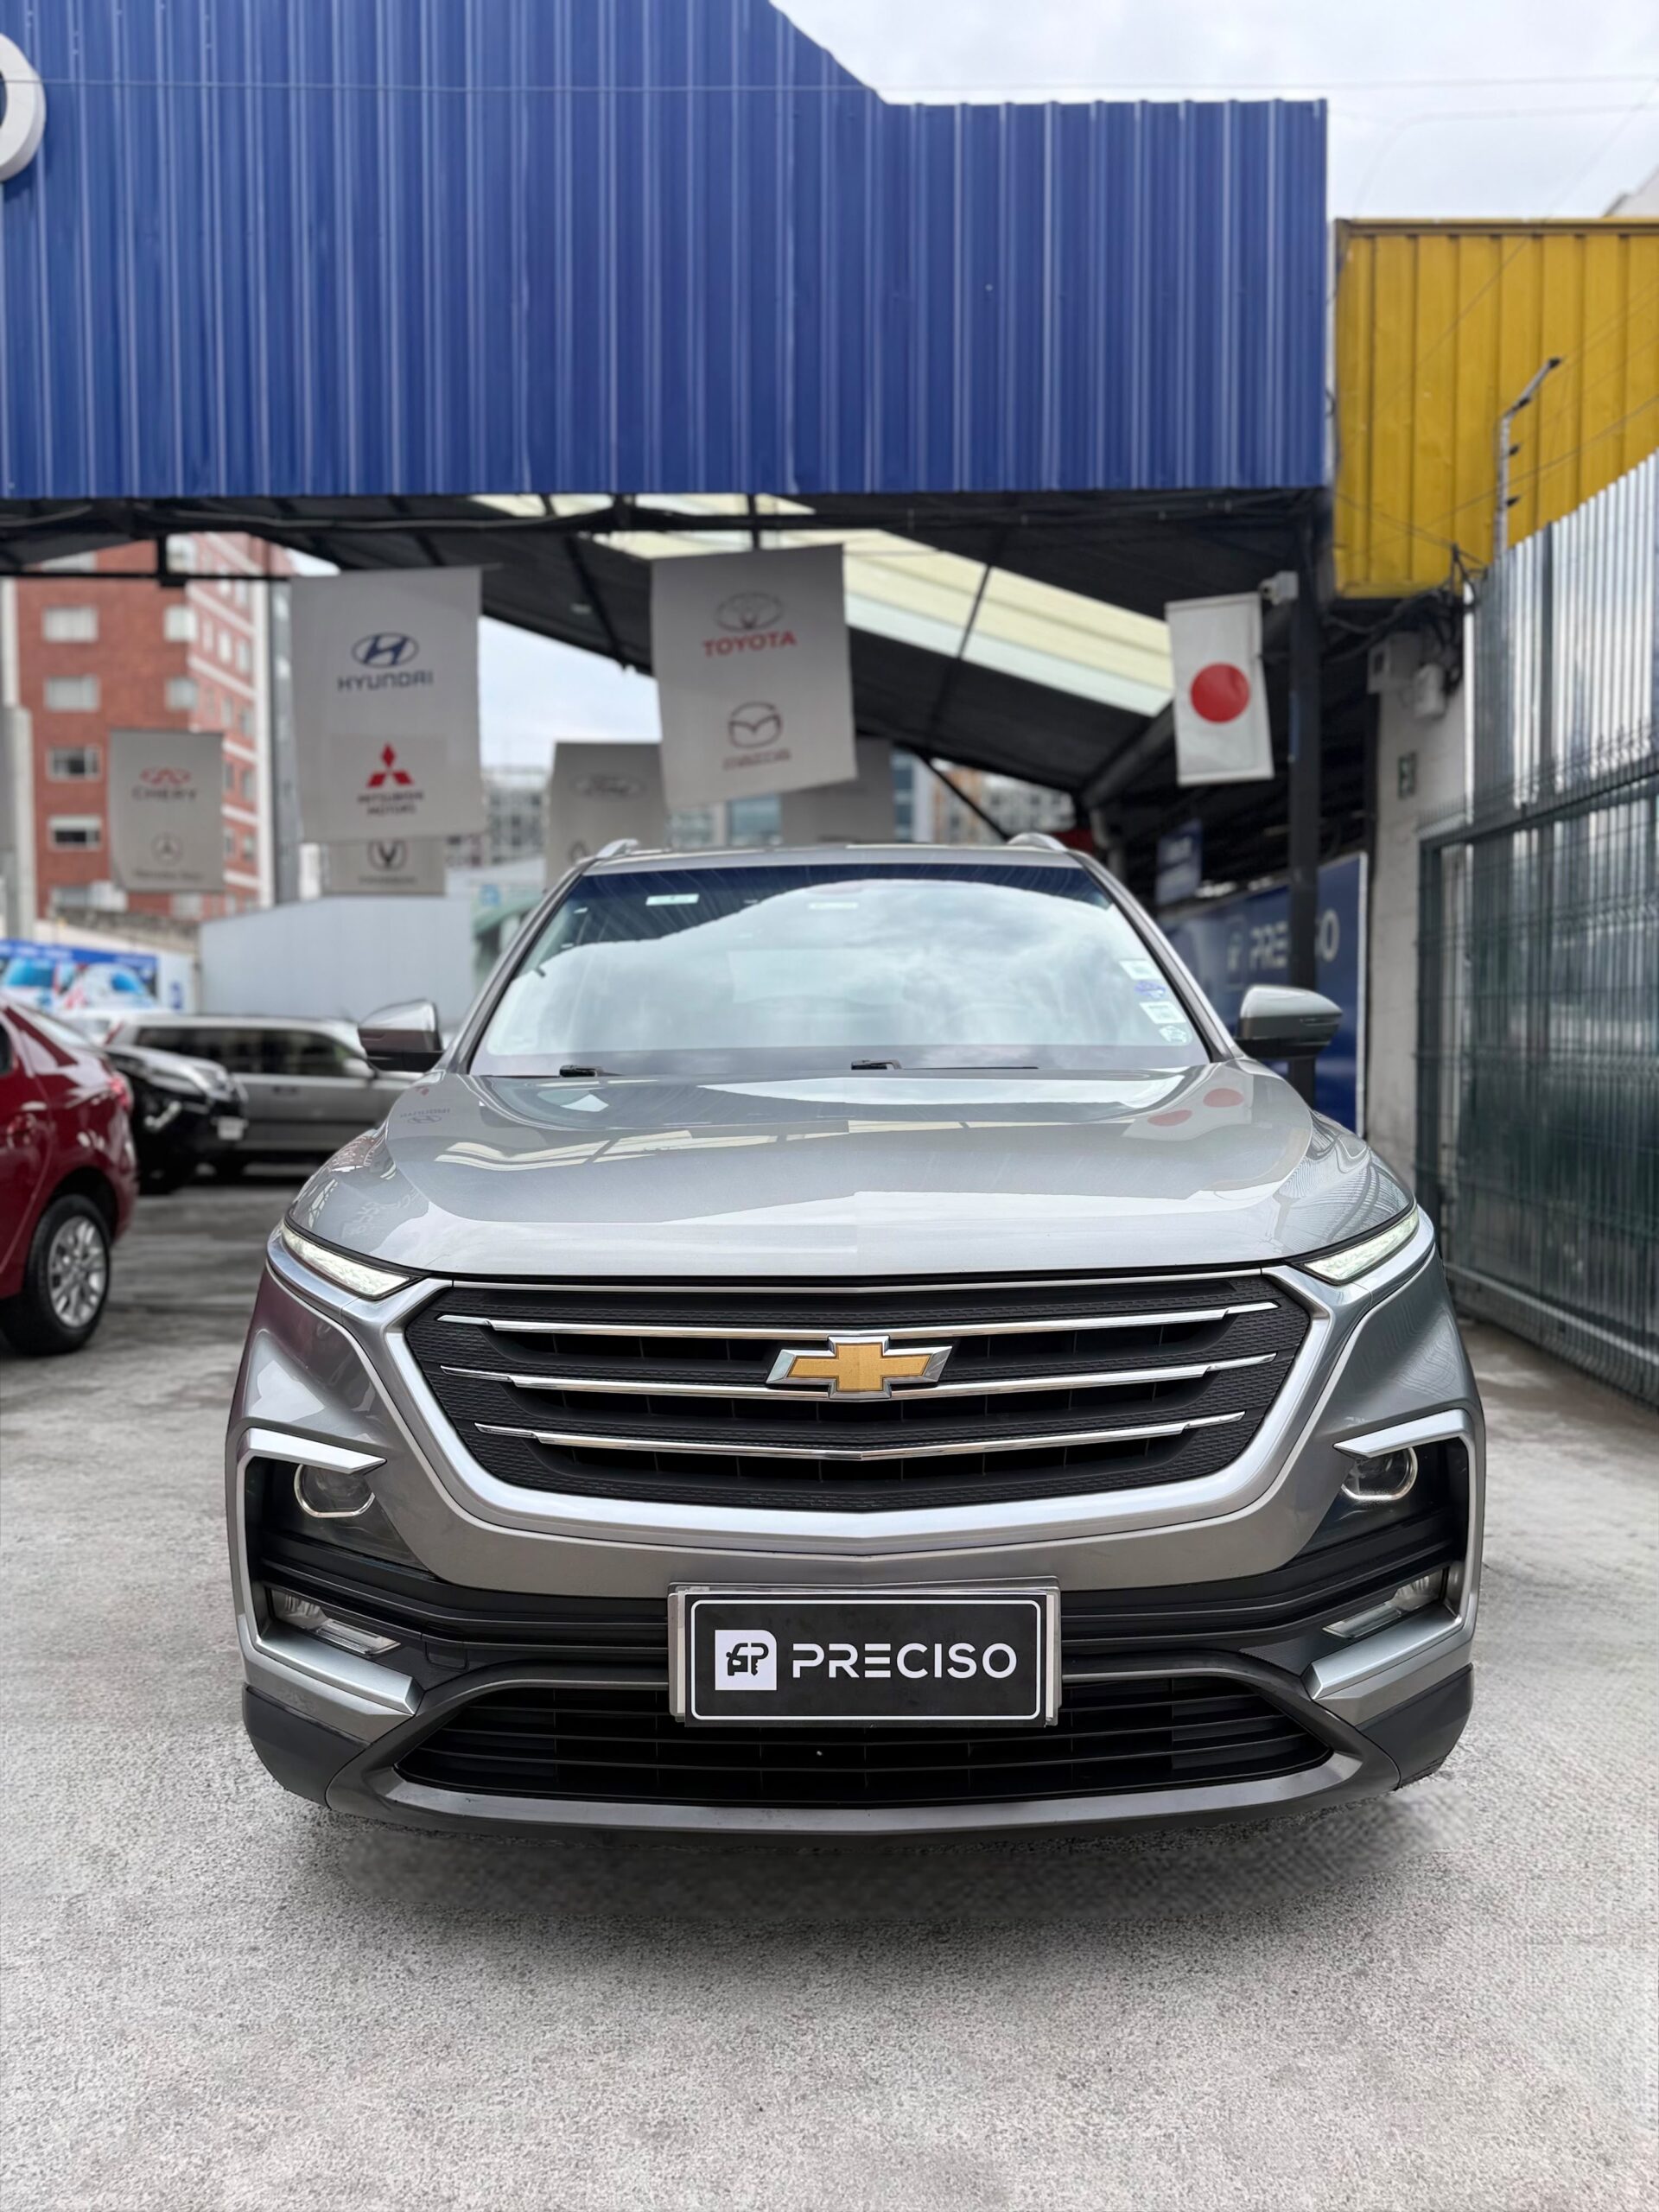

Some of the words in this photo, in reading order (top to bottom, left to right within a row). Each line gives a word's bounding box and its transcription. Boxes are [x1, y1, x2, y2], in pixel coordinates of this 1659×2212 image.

[702, 630, 798, 657] TOYOTA
[337, 669, 434, 690] HYUNDAI
[792, 1643, 1017, 1679] PRECISO
